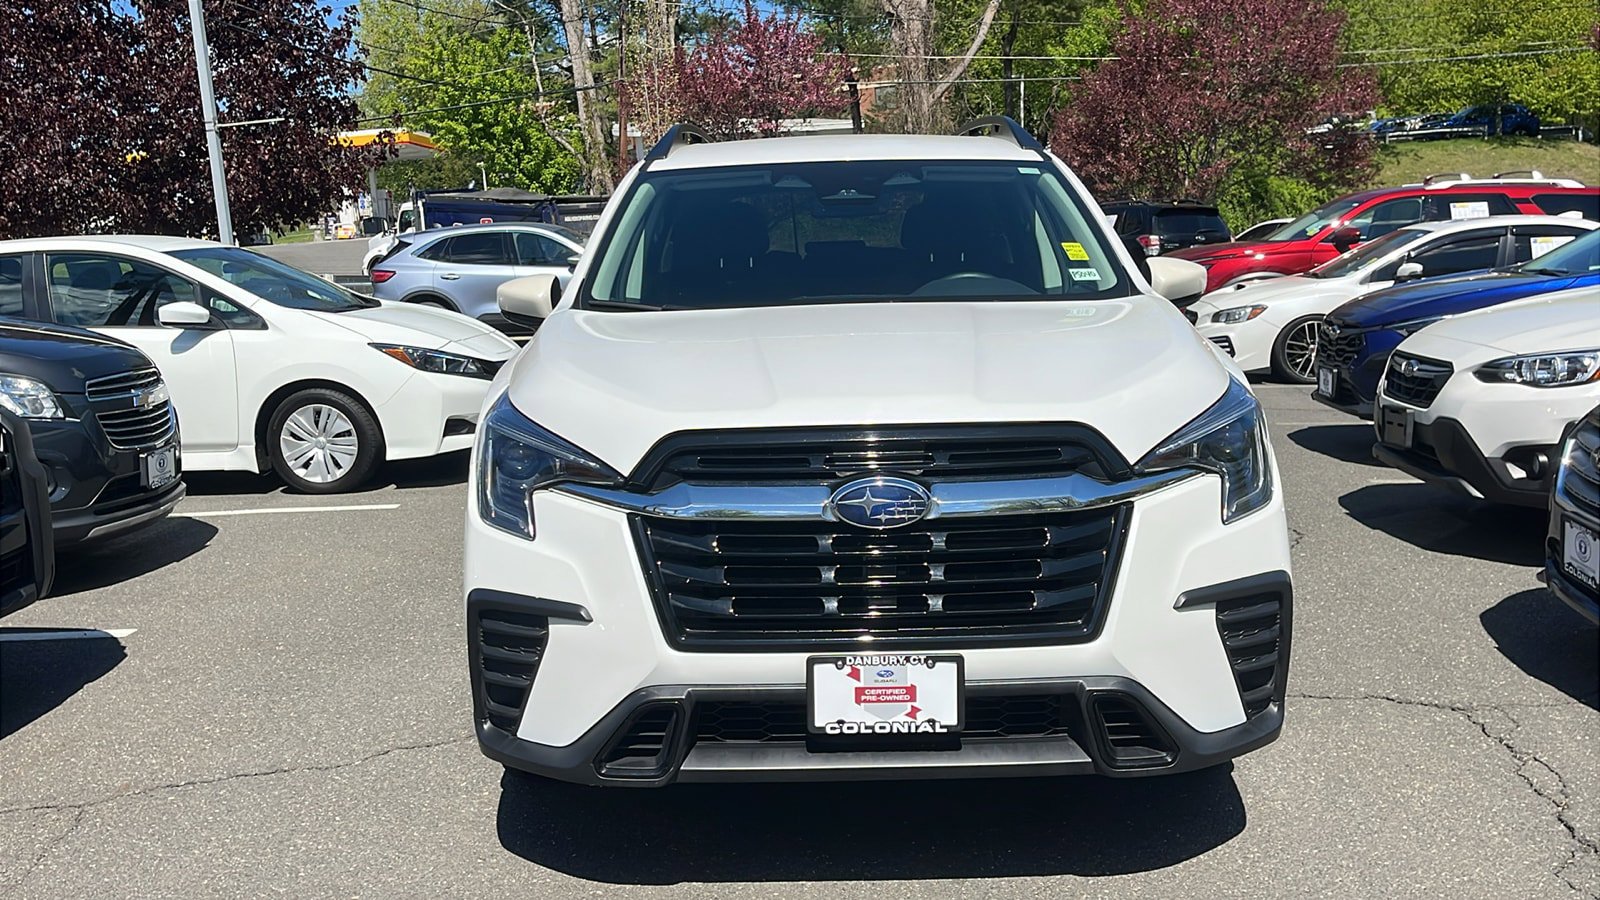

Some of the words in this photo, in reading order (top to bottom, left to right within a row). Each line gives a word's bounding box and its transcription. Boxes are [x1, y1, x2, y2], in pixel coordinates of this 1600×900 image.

[846, 655, 907, 667] DANBURY,
[908, 655, 927, 665] CT
[861, 694, 911, 702] PRE-OWNED
[825, 721, 948, 735] COLONIAL
